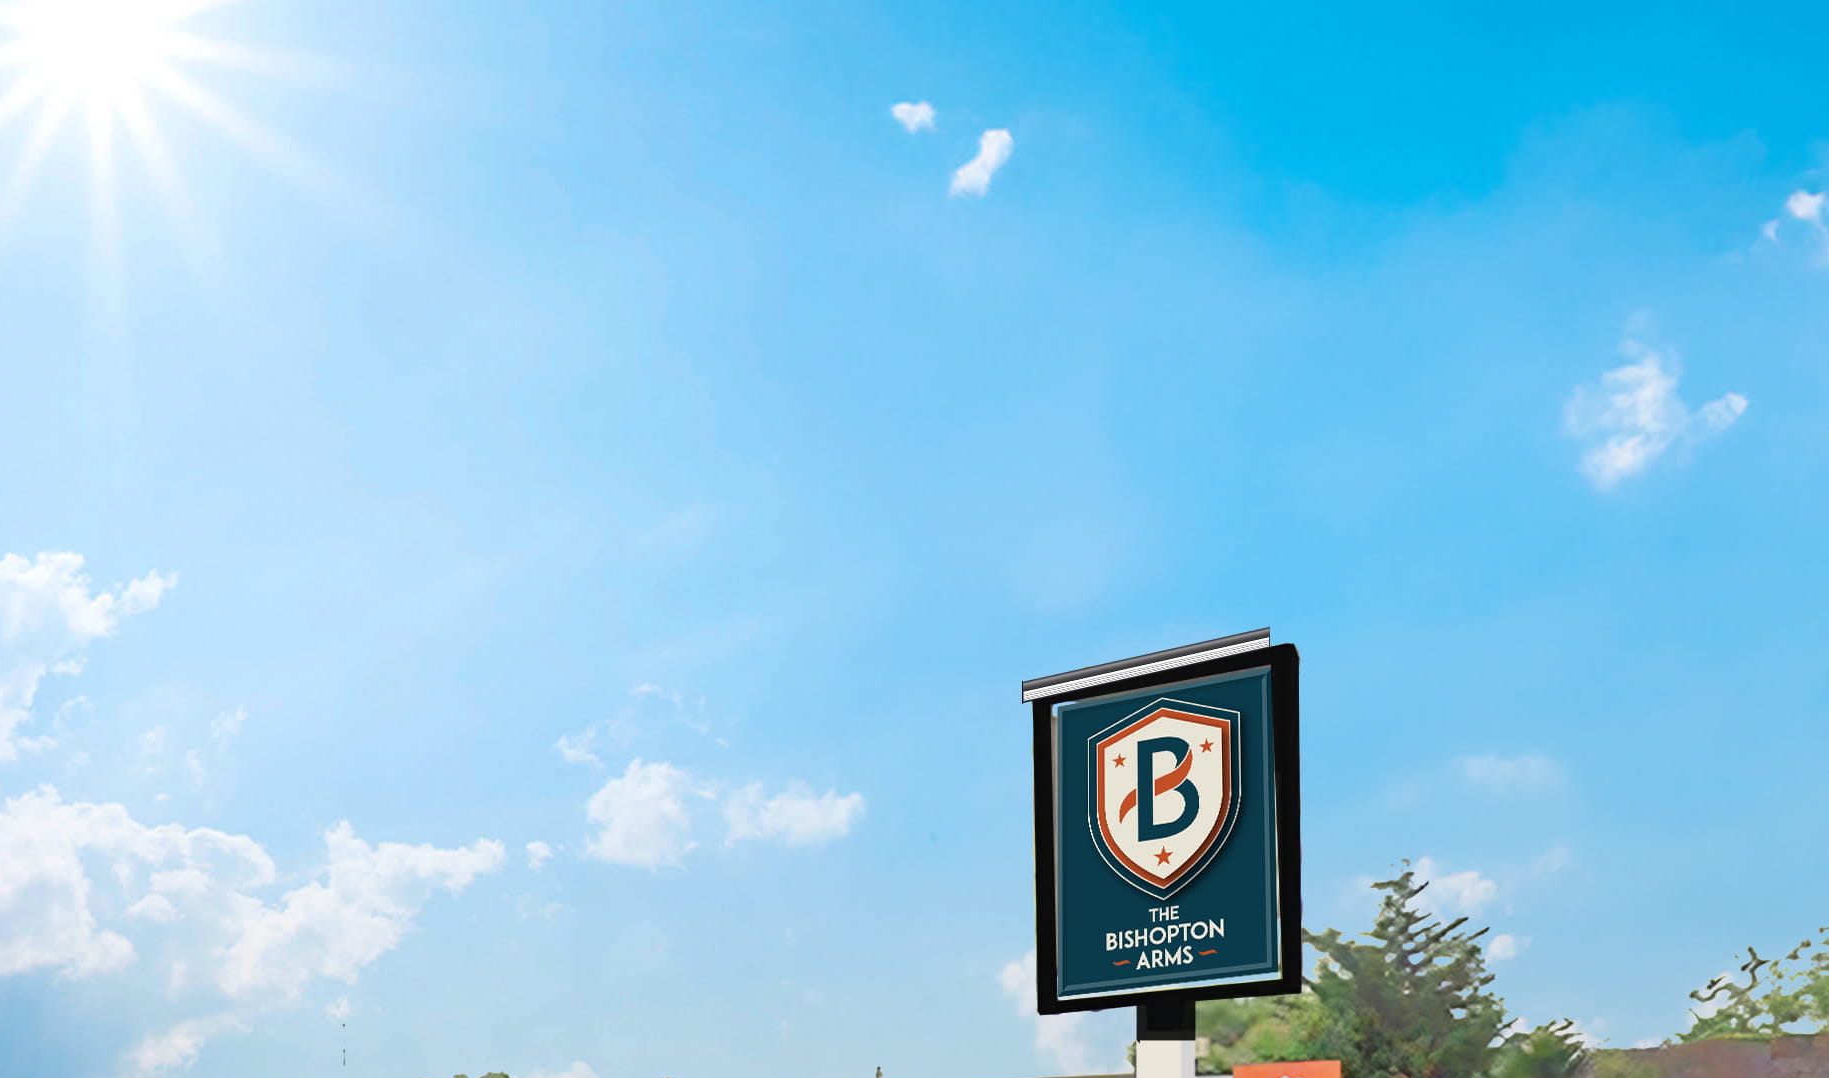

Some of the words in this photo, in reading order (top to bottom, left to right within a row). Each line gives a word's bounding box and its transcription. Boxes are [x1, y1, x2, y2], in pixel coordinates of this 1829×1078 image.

[1137, 736, 1200, 842] B
[1149, 905, 1179, 922] THE
[1106, 918, 1225, 951] BISHOPTON
[1136, 945, 1194, 970] ARMS
